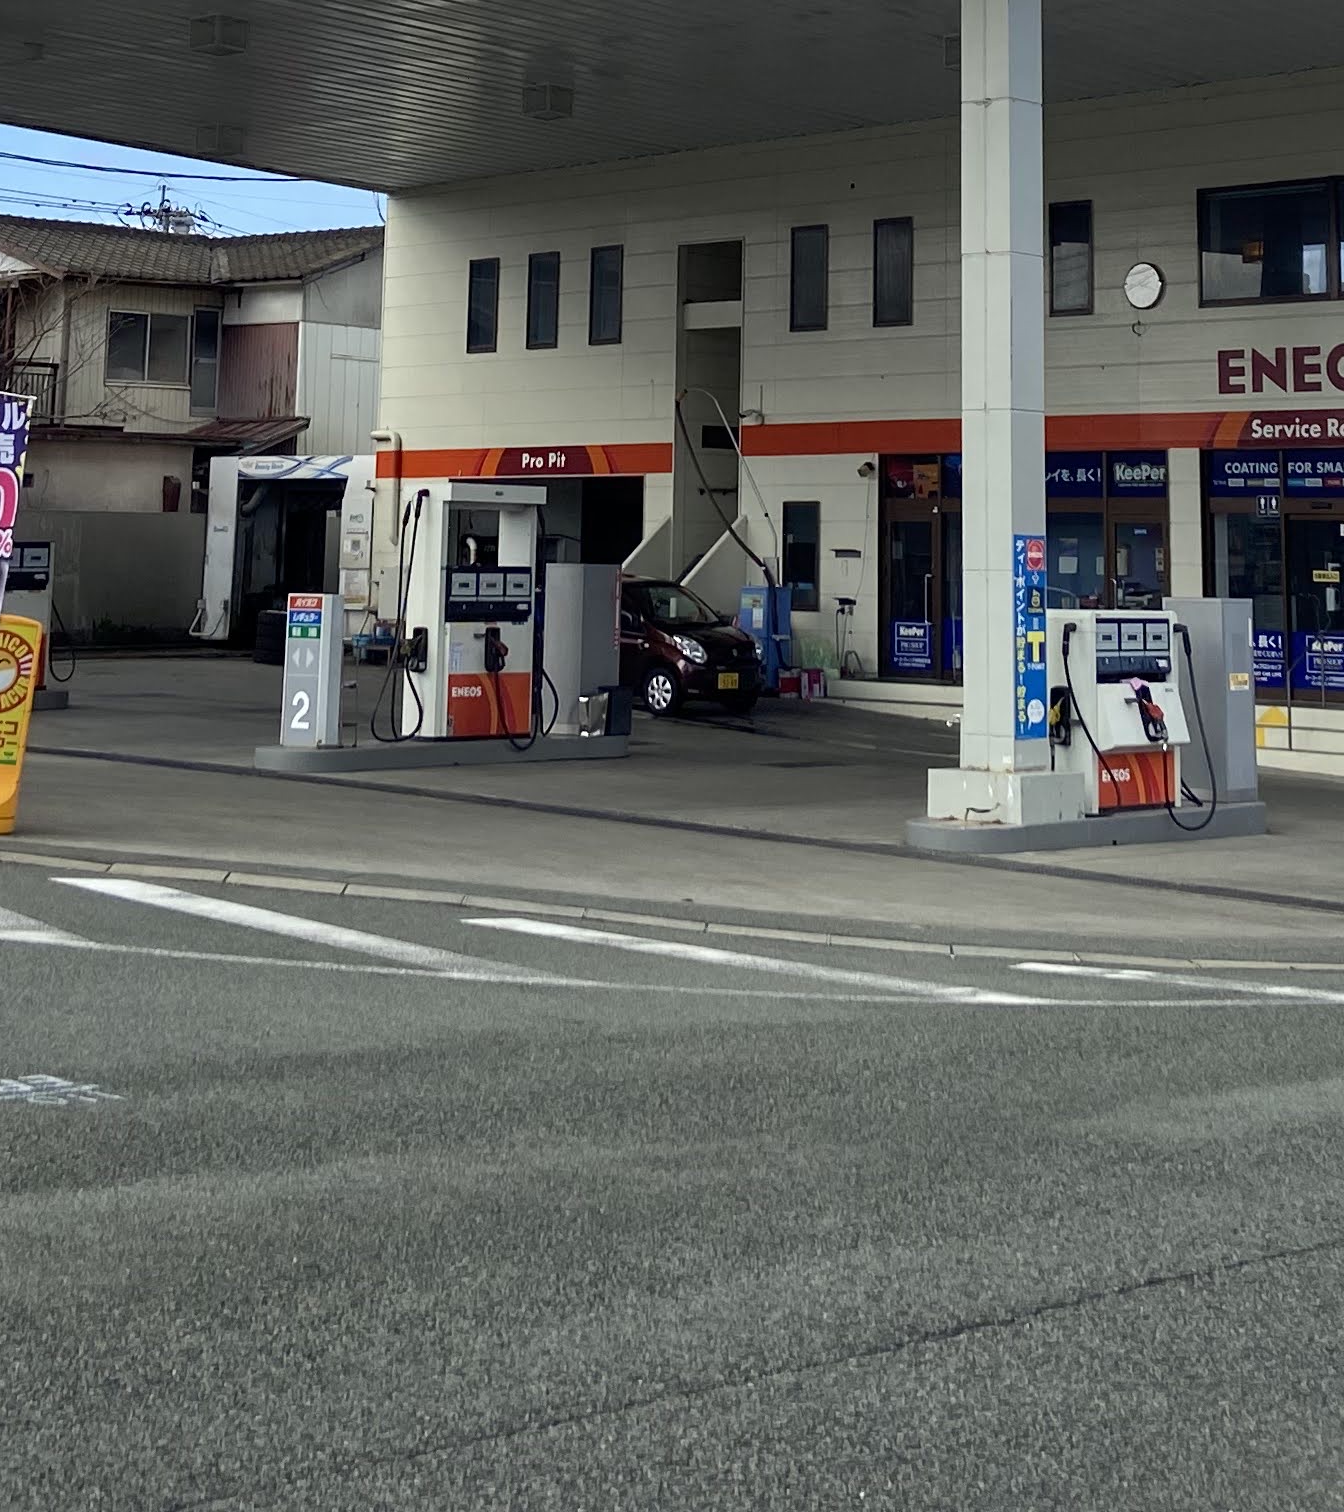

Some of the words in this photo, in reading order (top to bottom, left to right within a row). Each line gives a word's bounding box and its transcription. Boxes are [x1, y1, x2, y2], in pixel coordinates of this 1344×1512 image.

[1251, 417, 1321, 438] Service
[522, 453, 544, 468] Pro
[548, 451, 566, 468] Pit
[1224, 462, 1279, 474] COATING
[1288, 462, 1312, 473] FOR
[1114, 462, 1167, 483] KeePer
[451, 686, 482, 697] ENEOS
[290, 691, 310, 730] 2
